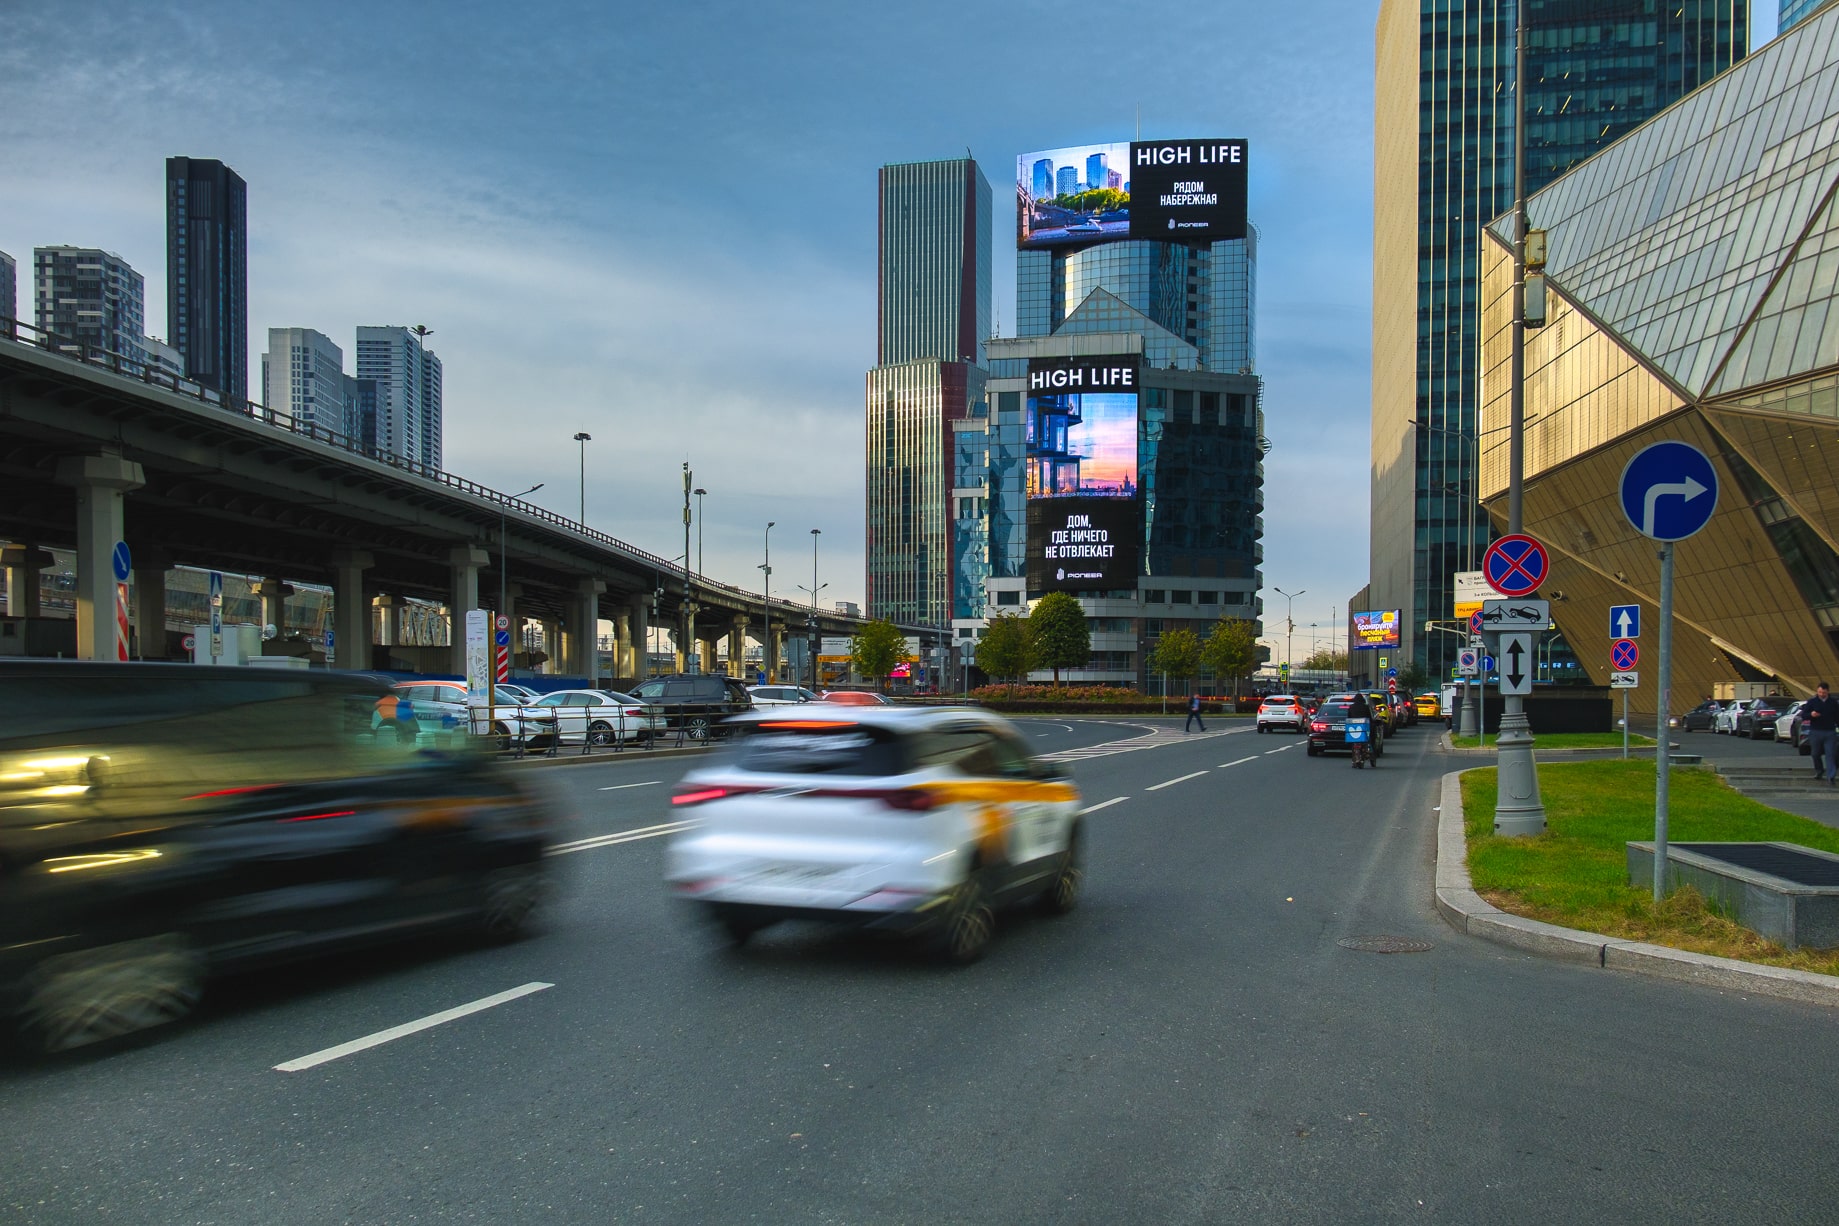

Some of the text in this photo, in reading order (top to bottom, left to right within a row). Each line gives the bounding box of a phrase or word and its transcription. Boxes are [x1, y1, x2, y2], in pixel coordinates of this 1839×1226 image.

[1137, 145, 1241, 166] HIGH LIFE
[1173, 181, 1204, 193] РЯДОМ
[1160, 192, 1217, 206] НАБЕРЕЖНАЯ
[1031, 368, 1132, 390] HIGH LIFE
[1067, 515, 1092, 529] ДОМ,
[1051, 529, 1108, 545] ГДЕ НИЧЕГО
[1045, 545, 1115, 559] НЕ ОТВЛЕКАЕТ
